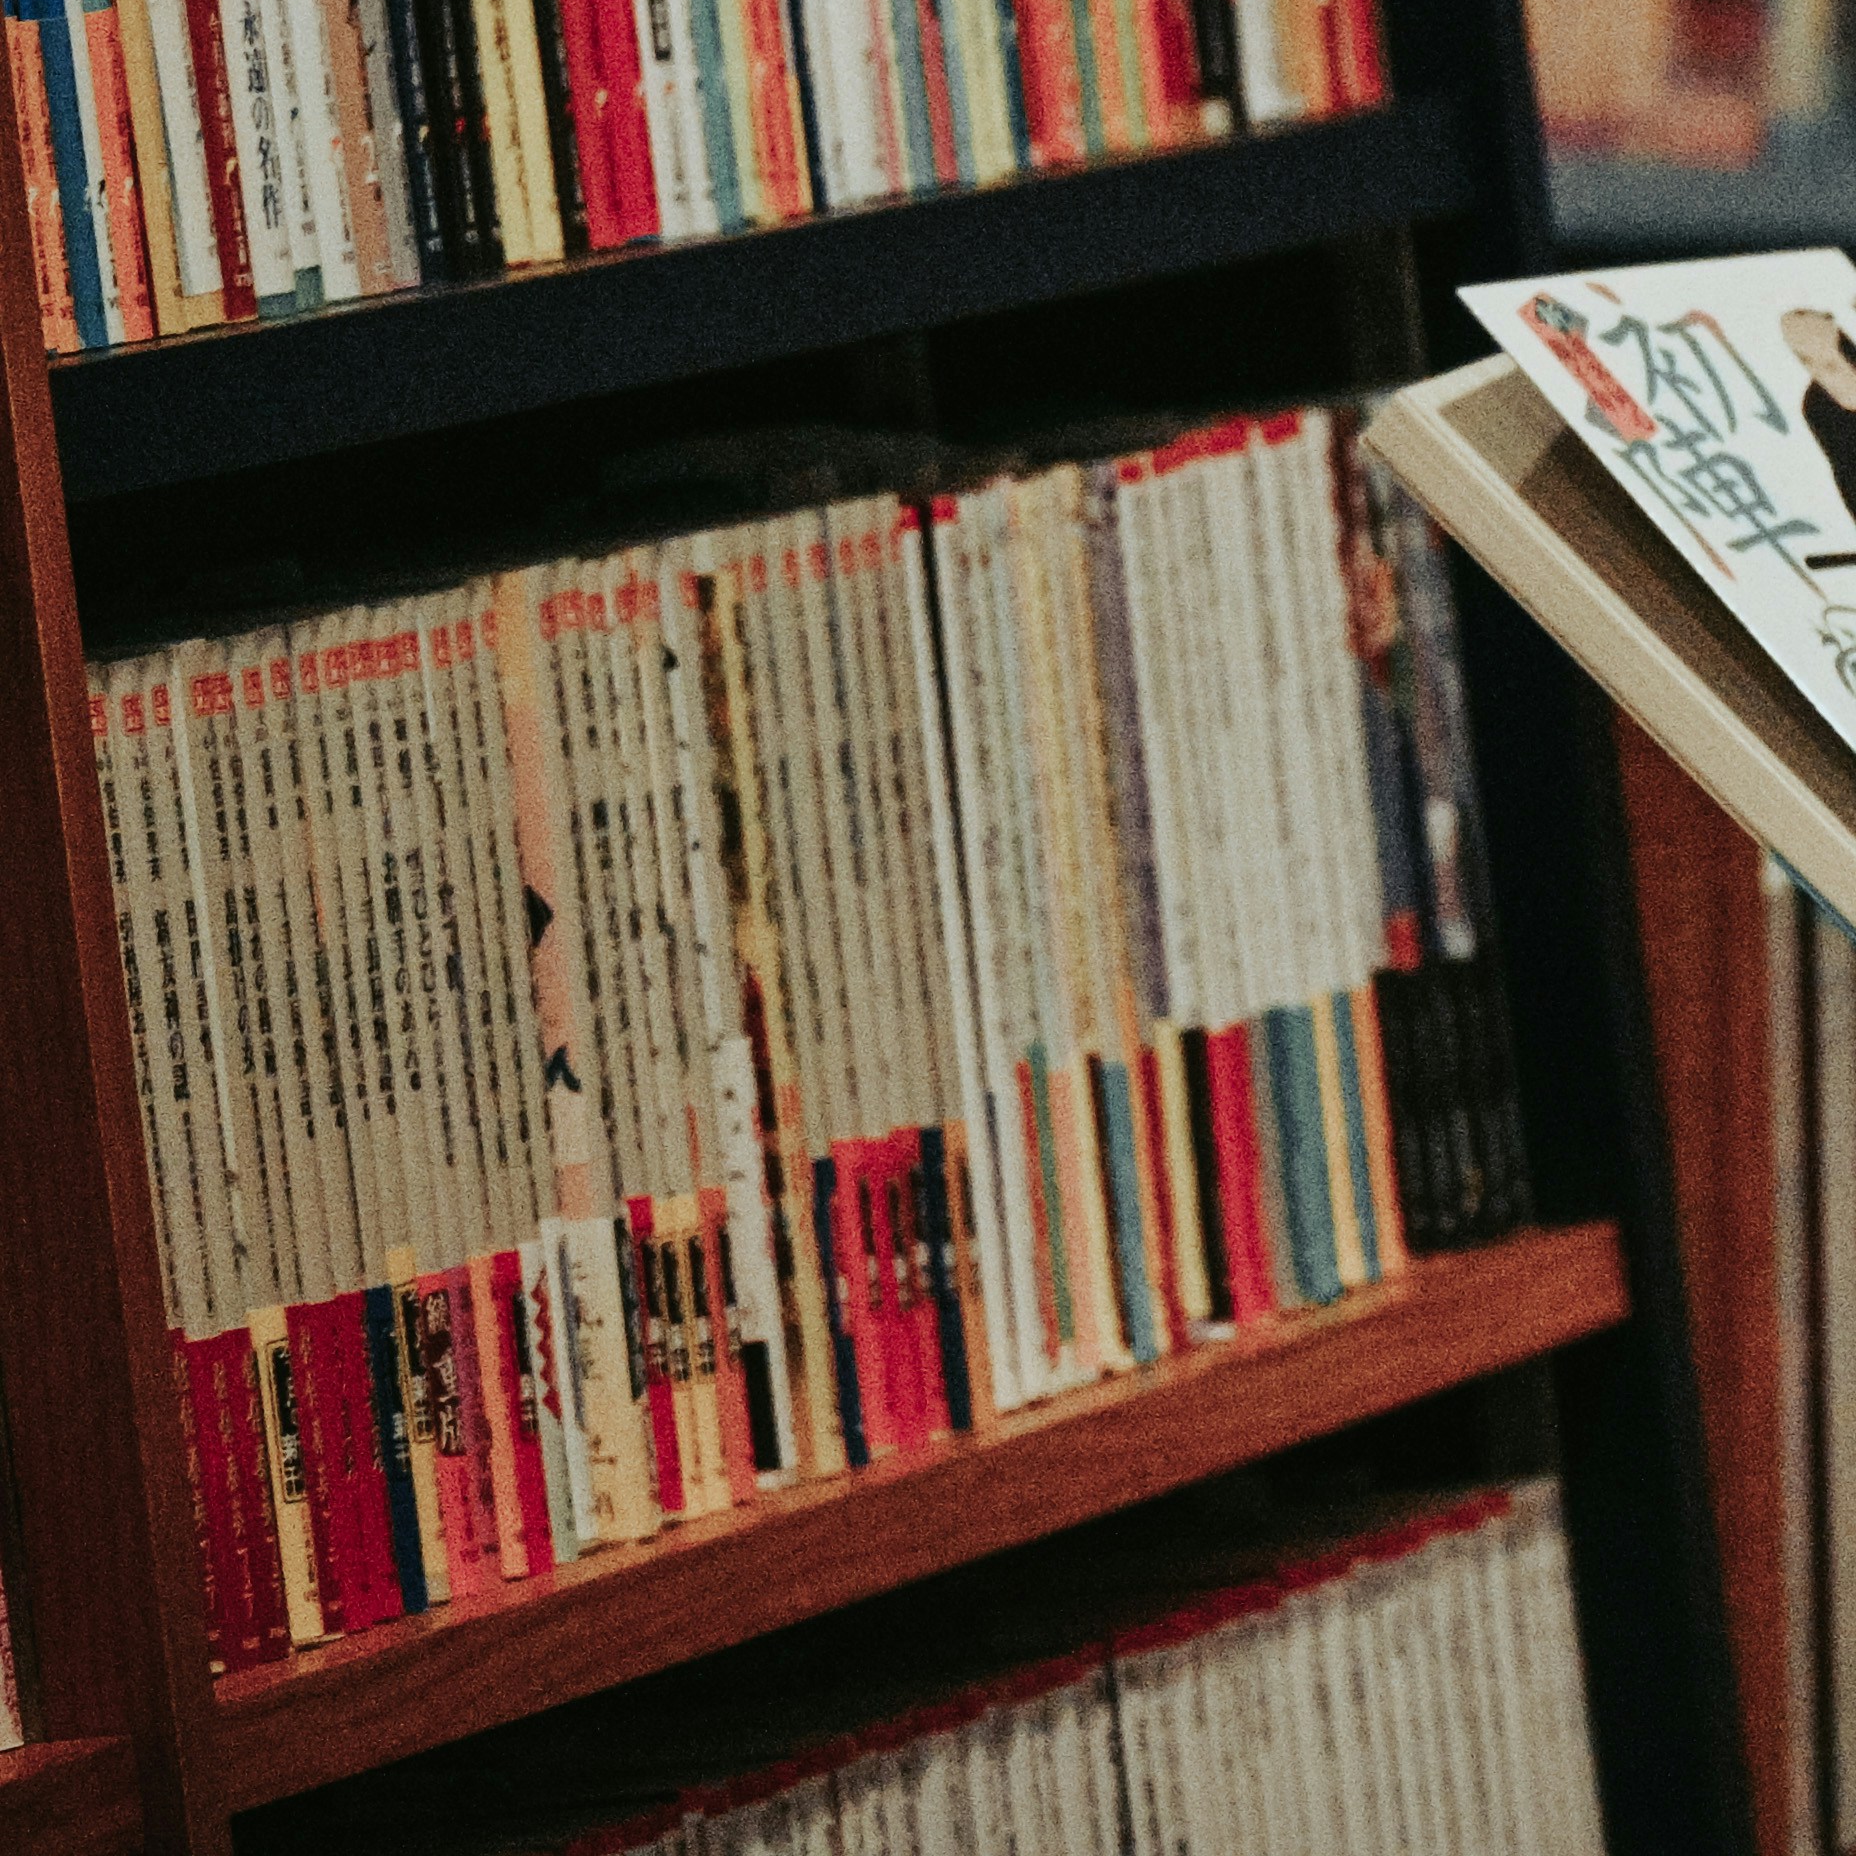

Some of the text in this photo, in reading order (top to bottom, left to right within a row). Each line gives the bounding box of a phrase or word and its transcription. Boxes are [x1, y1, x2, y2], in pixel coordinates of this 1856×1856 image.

[242, 0, 283, 231] 永遠の名作
[1585, 281, 1829, 603] 初陣
